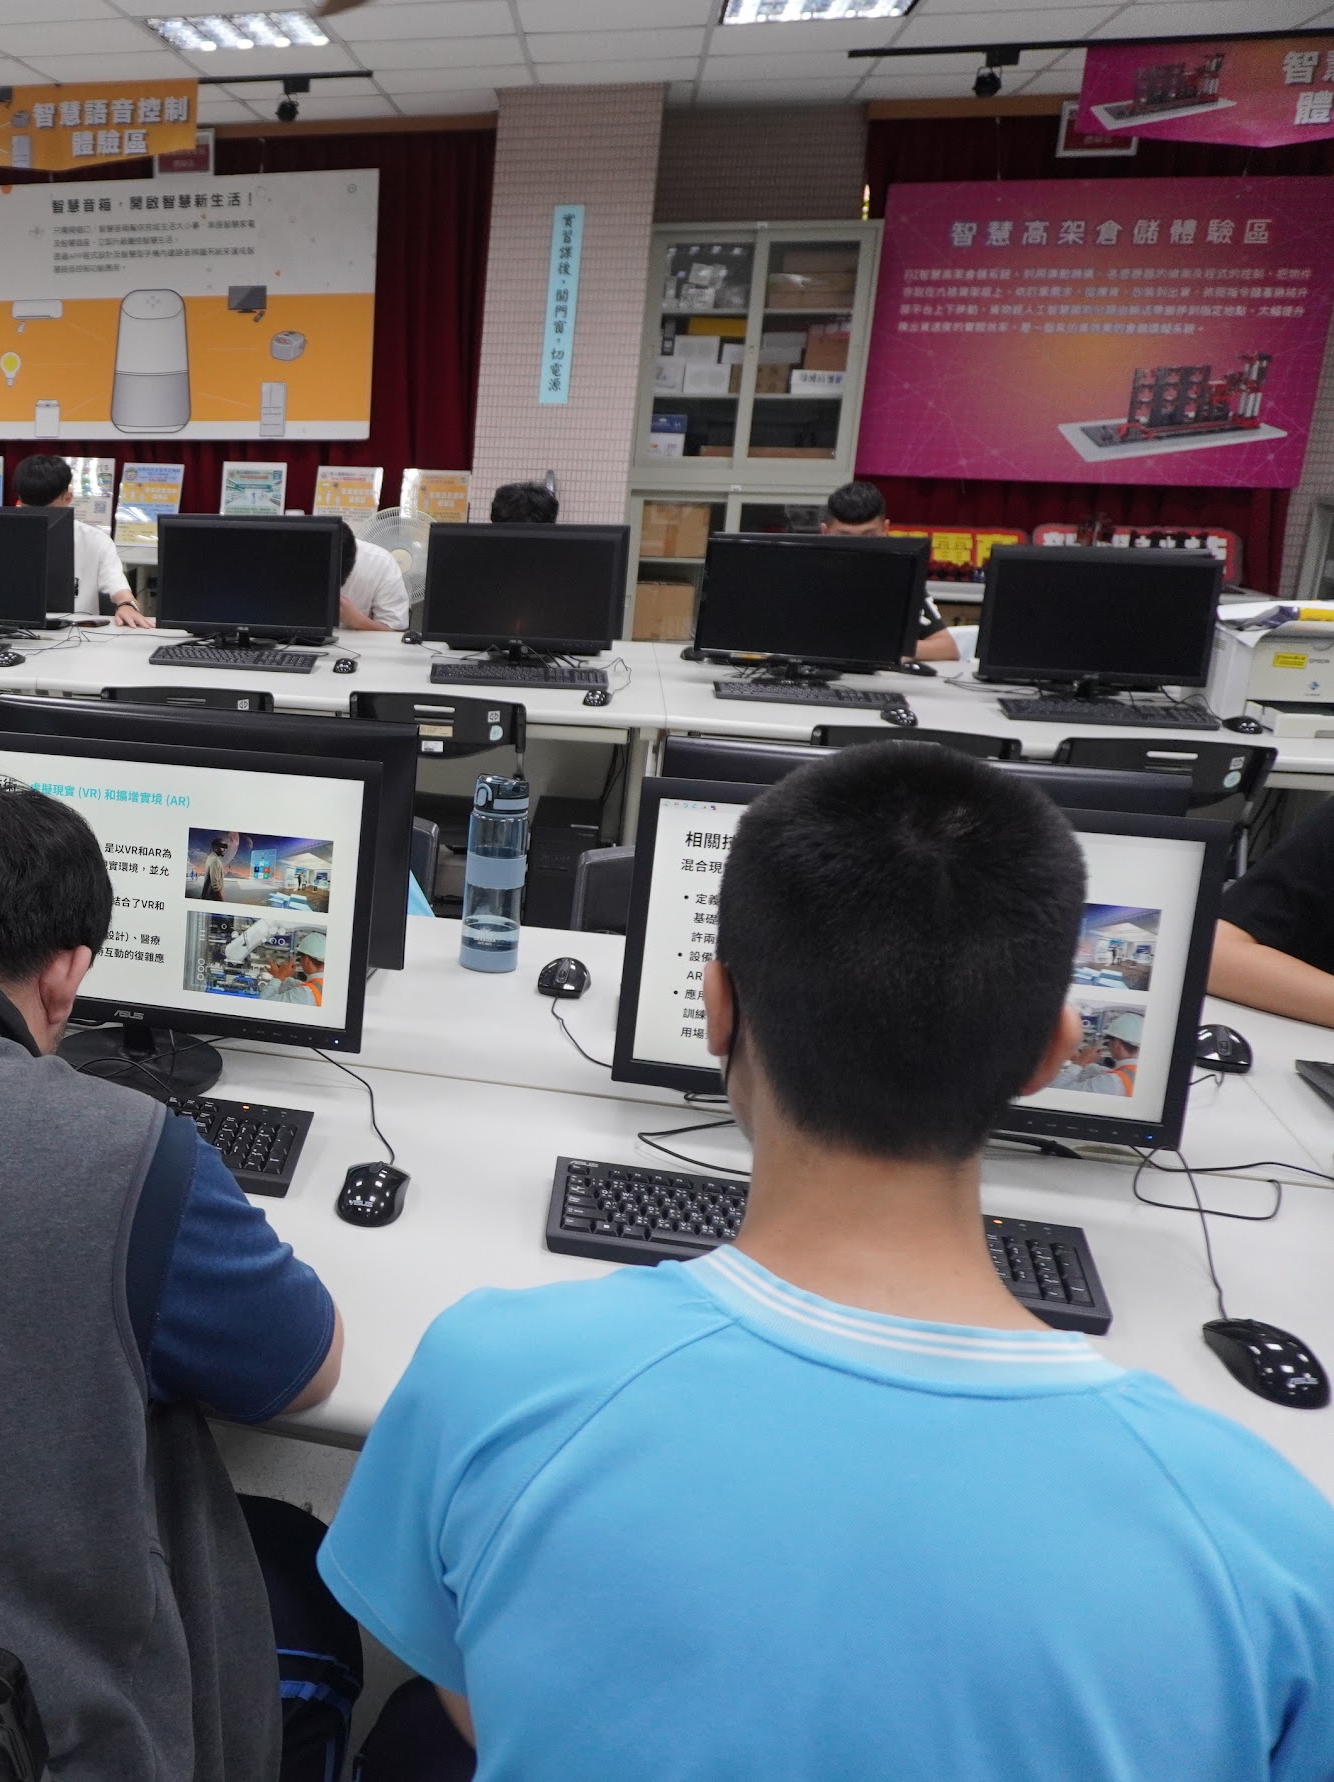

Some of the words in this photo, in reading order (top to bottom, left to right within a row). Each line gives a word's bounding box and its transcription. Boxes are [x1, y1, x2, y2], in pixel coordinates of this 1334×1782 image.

[33, 96, 189, 128] 智慧語音控制
[72, 129, 147, 157] 體驗區
[951, 218, 1272, 247] 智慧高架倉儲體驗區
[78, 788, 102, 800] (VR)
[104, 789, 163, 806] 和擴增實境
[166, 794, 190, 808] (AR)
[104, 843, 172, 859] 是以VR和AR為
[681, 858, 722, 874] 混合現
[693, 912, 719, 926] 基礎
[691, 932, 716, 945] 許兩
[689, 951, 714, 963] 設備
[686, 970, 703, 980] AR
[114, 1010, 144, 1020] ASUS
[682, 1008, 706, 1020] 訓練
[680, 1027, 708, 1040] 用場
